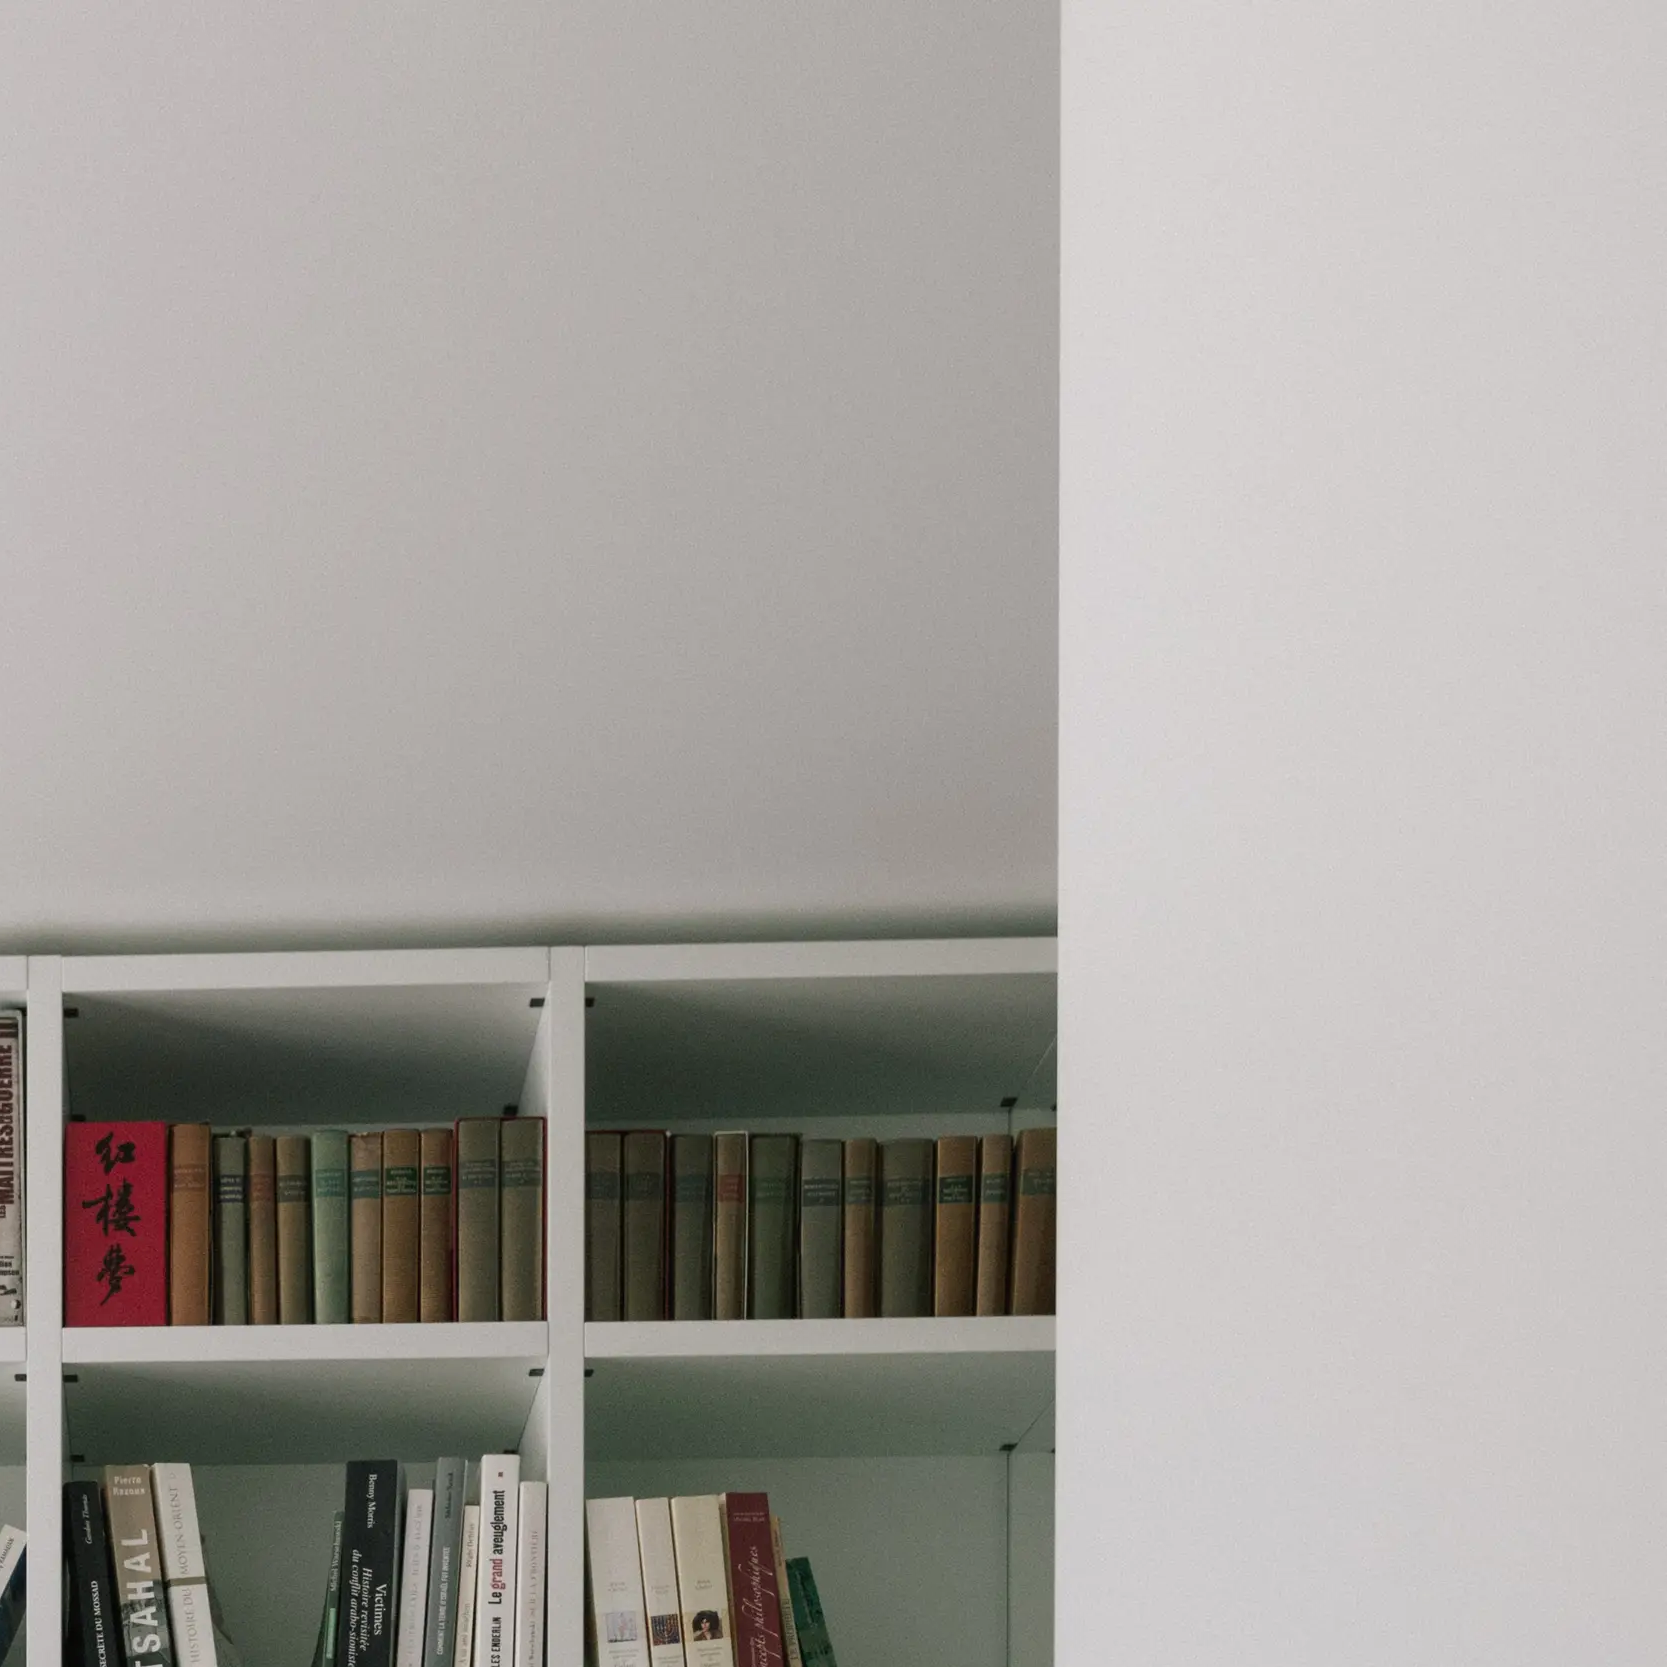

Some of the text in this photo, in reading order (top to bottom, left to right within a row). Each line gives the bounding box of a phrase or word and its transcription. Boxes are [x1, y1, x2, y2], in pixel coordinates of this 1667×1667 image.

[366, 1474, 378, 1529] Benny Morris
[351, 1548, 361, 1560] du
[488, 1490, 508, 1605] Le grand aveuglement
[349, 1562, 361, 1597] conflit
[359, 1567, 373, 1652] Histoire revisitée
[373, 1583, 388, 1636] Victimes
